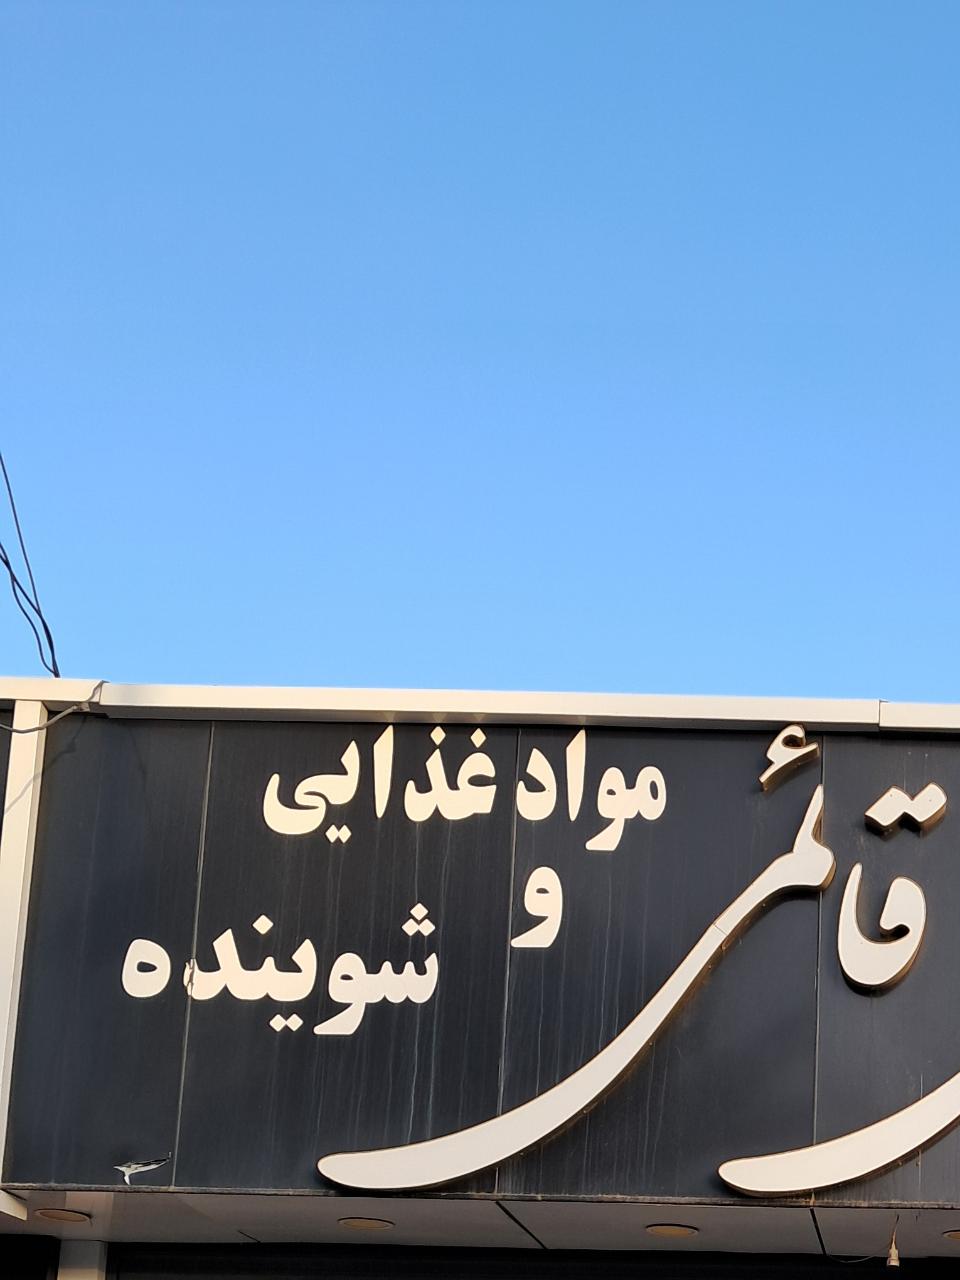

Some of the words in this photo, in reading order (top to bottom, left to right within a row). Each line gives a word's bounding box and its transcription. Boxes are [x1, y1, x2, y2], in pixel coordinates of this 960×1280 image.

[262, 724, 498, 843] غذایی
[515, 727, 667, 851] مواد
[510, 866, 564, 949] و
[120, 902, 439, 1036] شوینده
